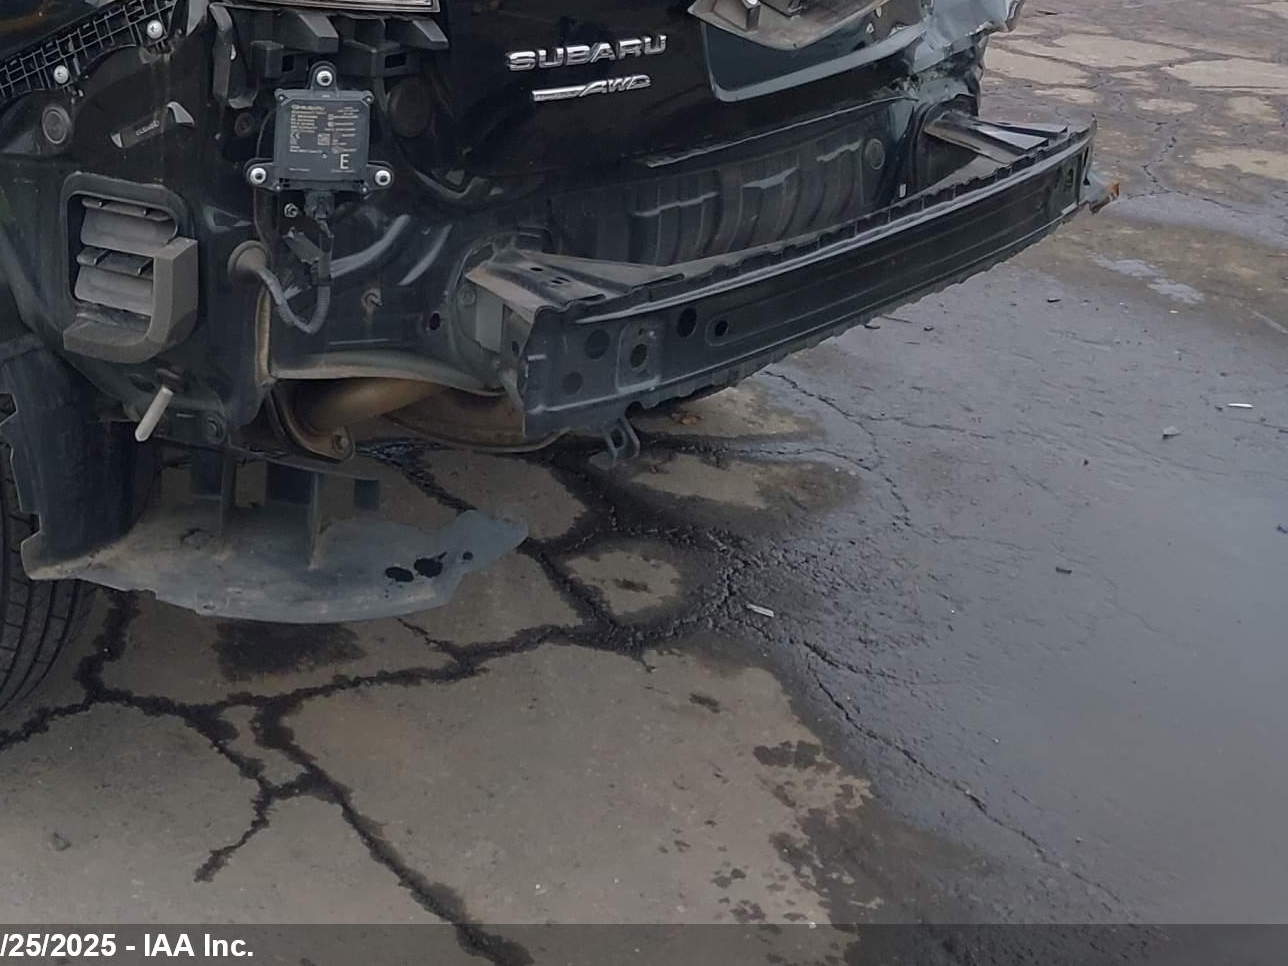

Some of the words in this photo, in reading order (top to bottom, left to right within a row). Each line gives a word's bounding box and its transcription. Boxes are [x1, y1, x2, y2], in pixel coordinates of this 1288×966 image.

[506, 34, 668, 72] SUBARU
[579, 74, 652, 97] AWD
[339, 153, 350, 170] E
